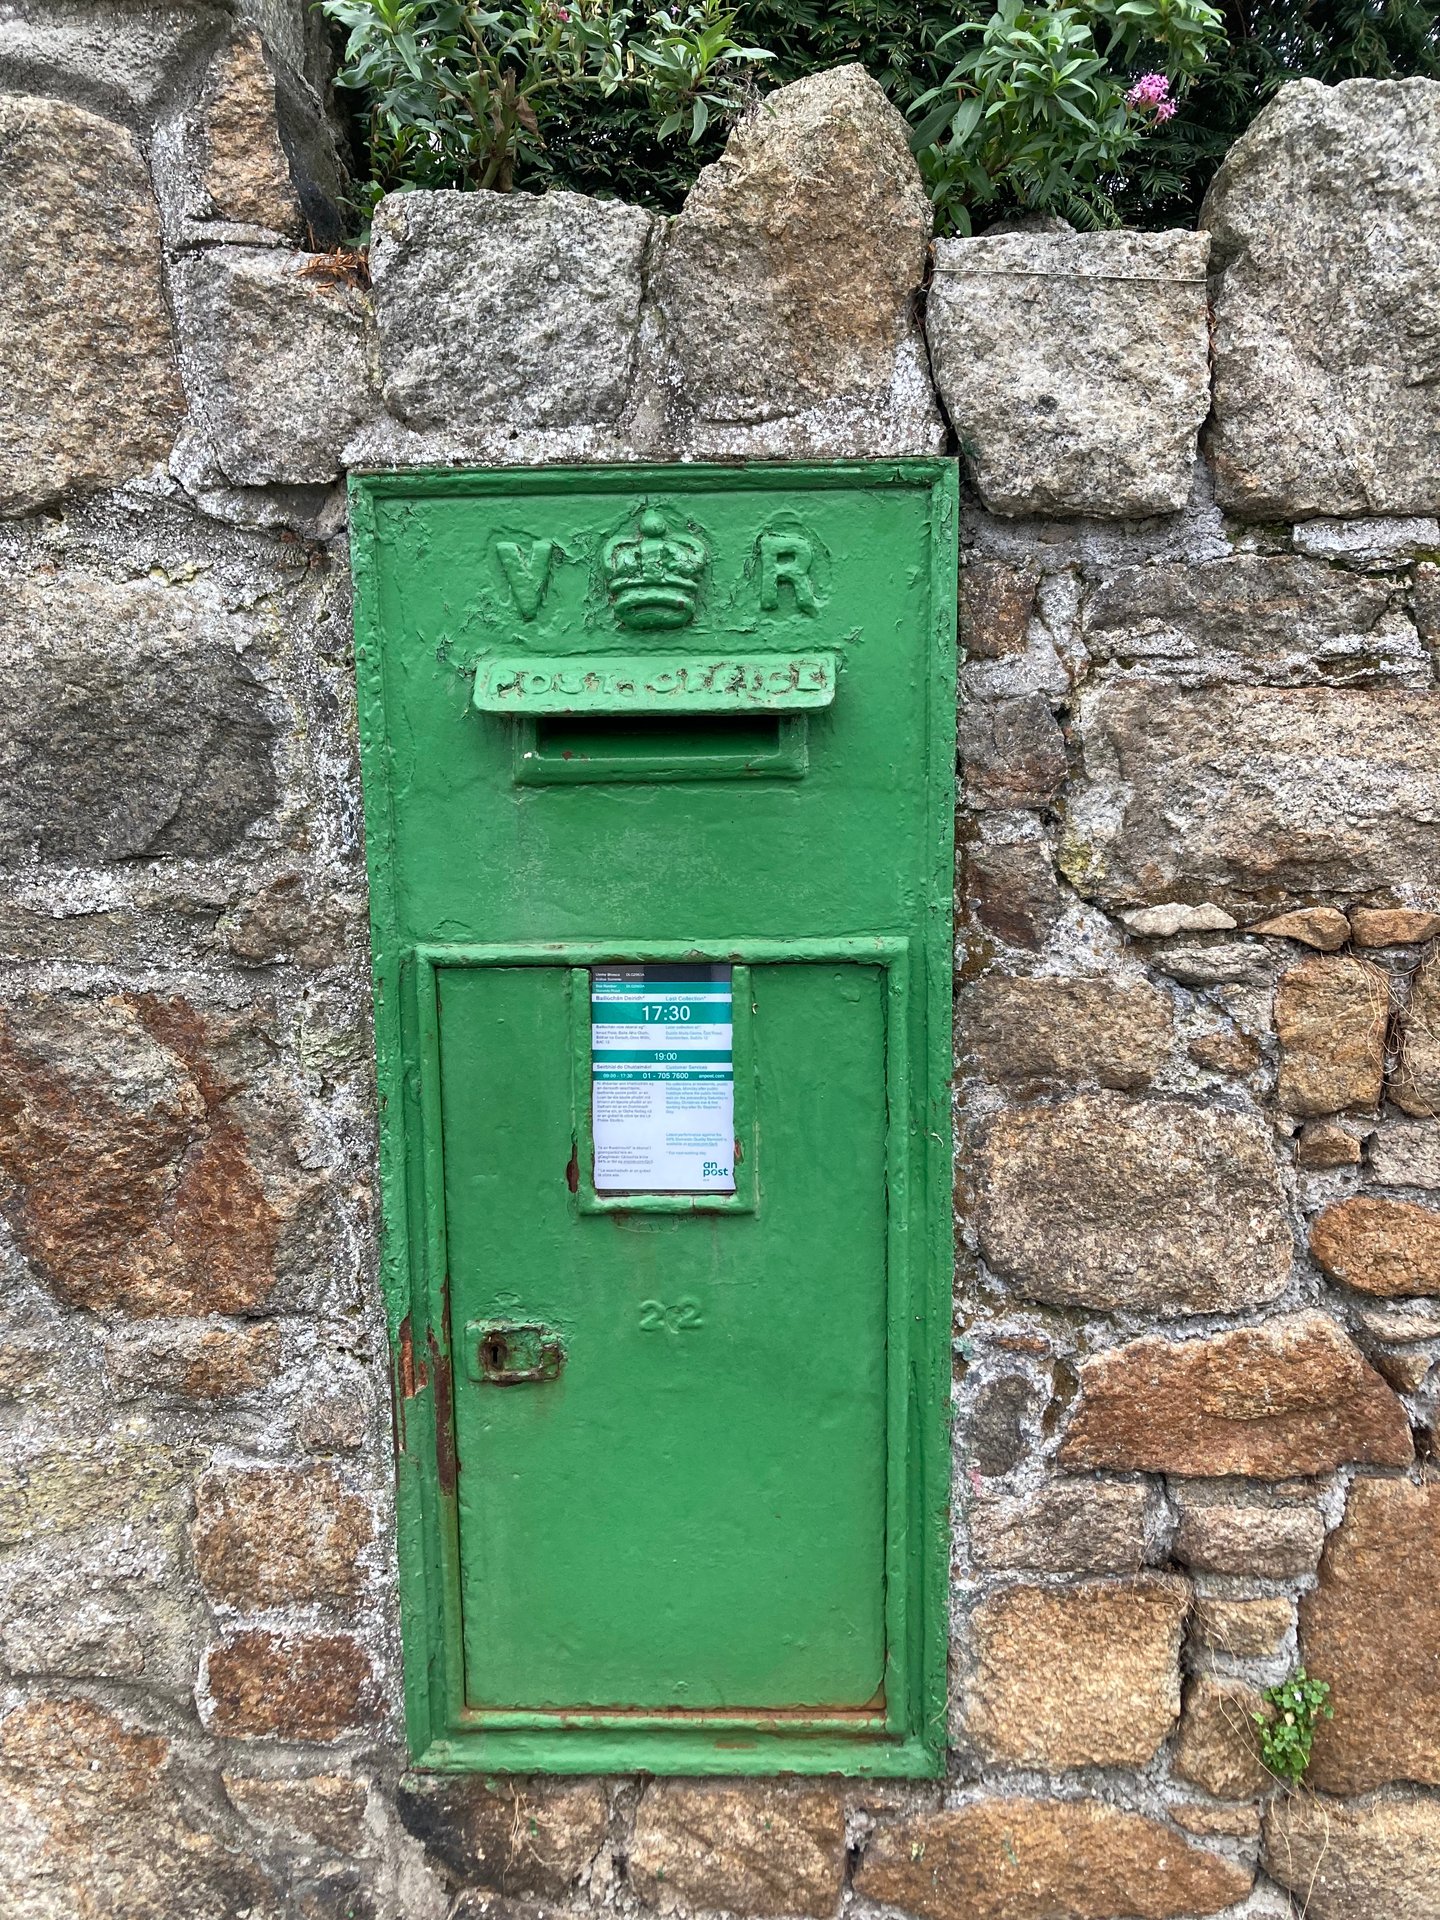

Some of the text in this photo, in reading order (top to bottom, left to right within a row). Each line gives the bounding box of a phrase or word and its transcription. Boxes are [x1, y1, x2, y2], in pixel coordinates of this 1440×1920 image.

[495, 535, 818, 622] V R
[642, 1005, 690, 1021] 17:30
[654, 1052, 677, 1060] 19:00
[703, 1161, 718, 1169] an
[703, 1167, 729, 1177] post
[639, 1297, 704, 1333] 22
